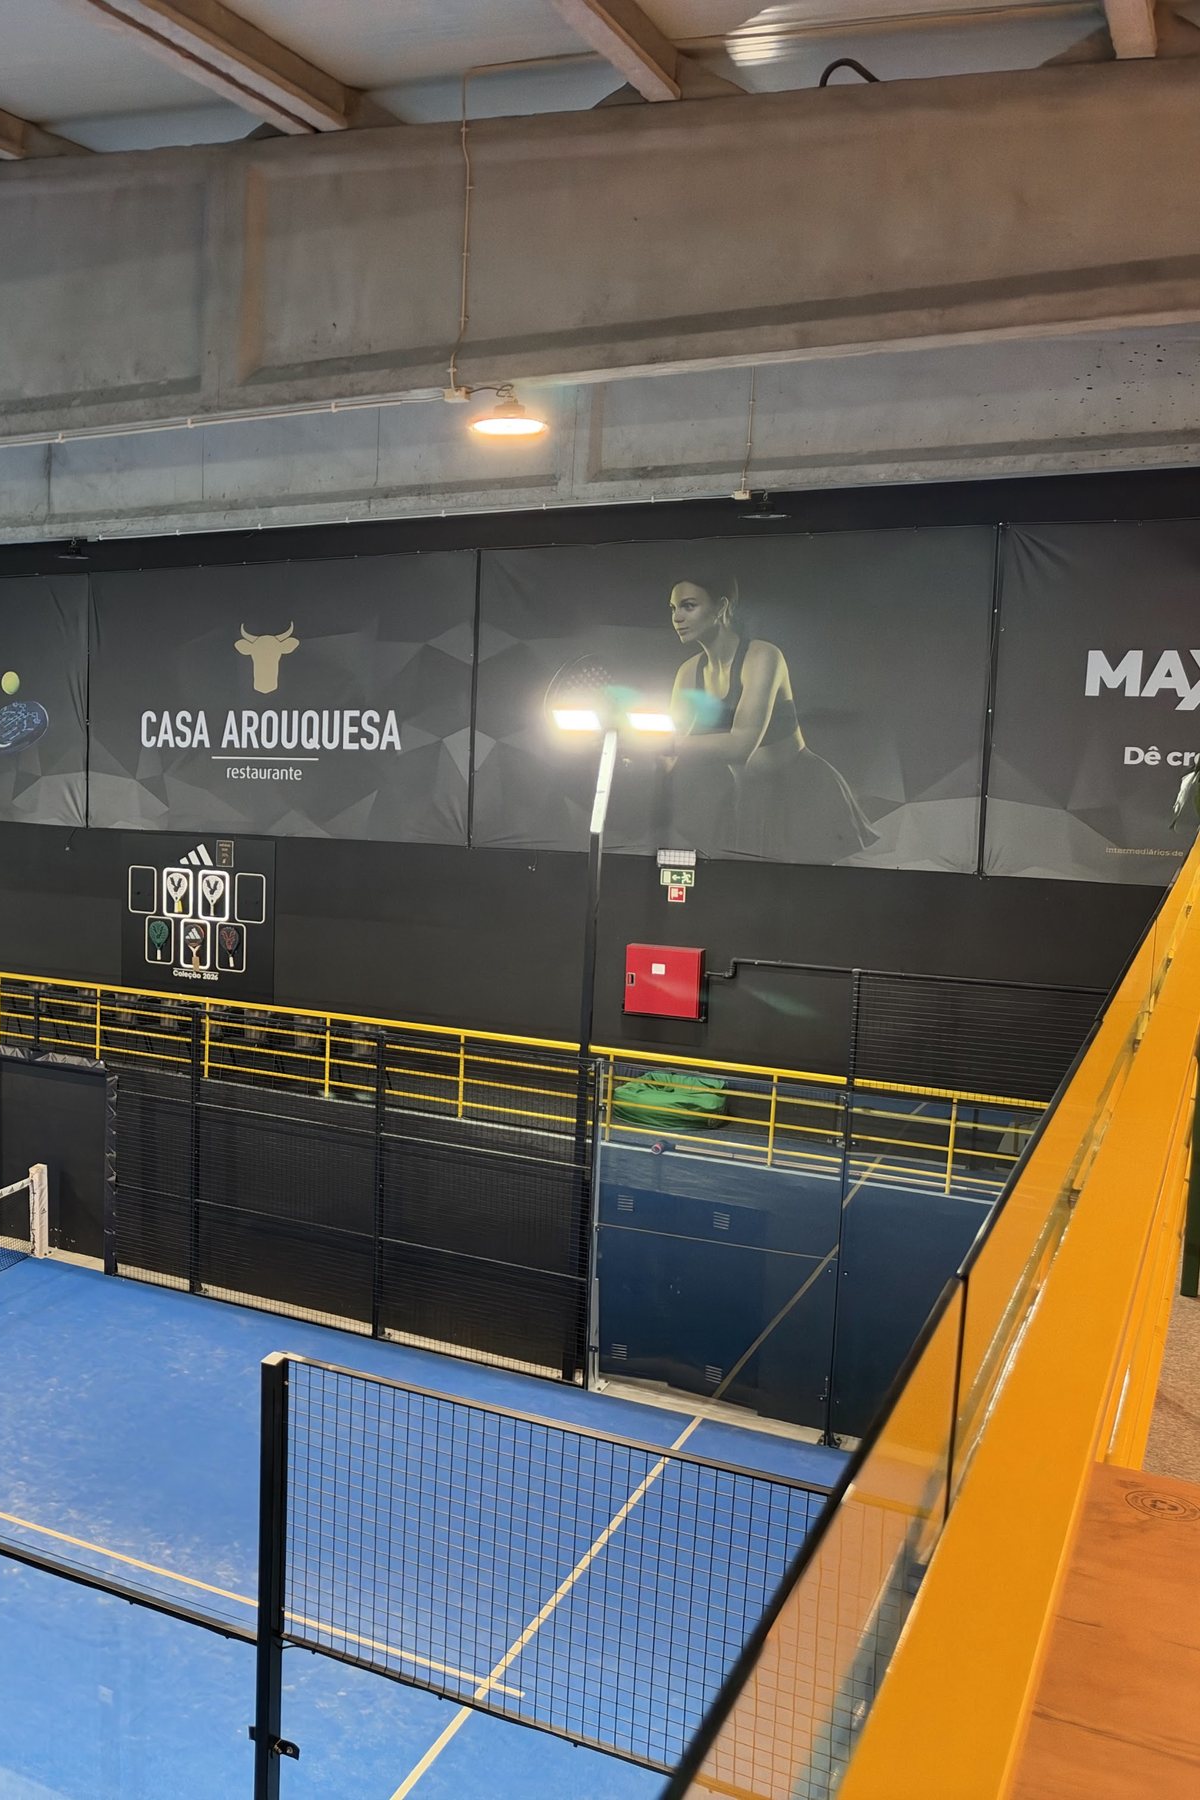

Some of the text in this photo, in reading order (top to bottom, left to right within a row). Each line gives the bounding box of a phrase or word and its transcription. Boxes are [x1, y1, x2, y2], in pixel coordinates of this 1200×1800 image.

[141, 709, 402, 750] CASA AROUQUESA
[1124, 746, 1161, 766] Dê
[226, 765, 302, 781] restaurante
[1106, 847, 1170, 857] Intermediários
[173, 969, 201, 980] Coleção
